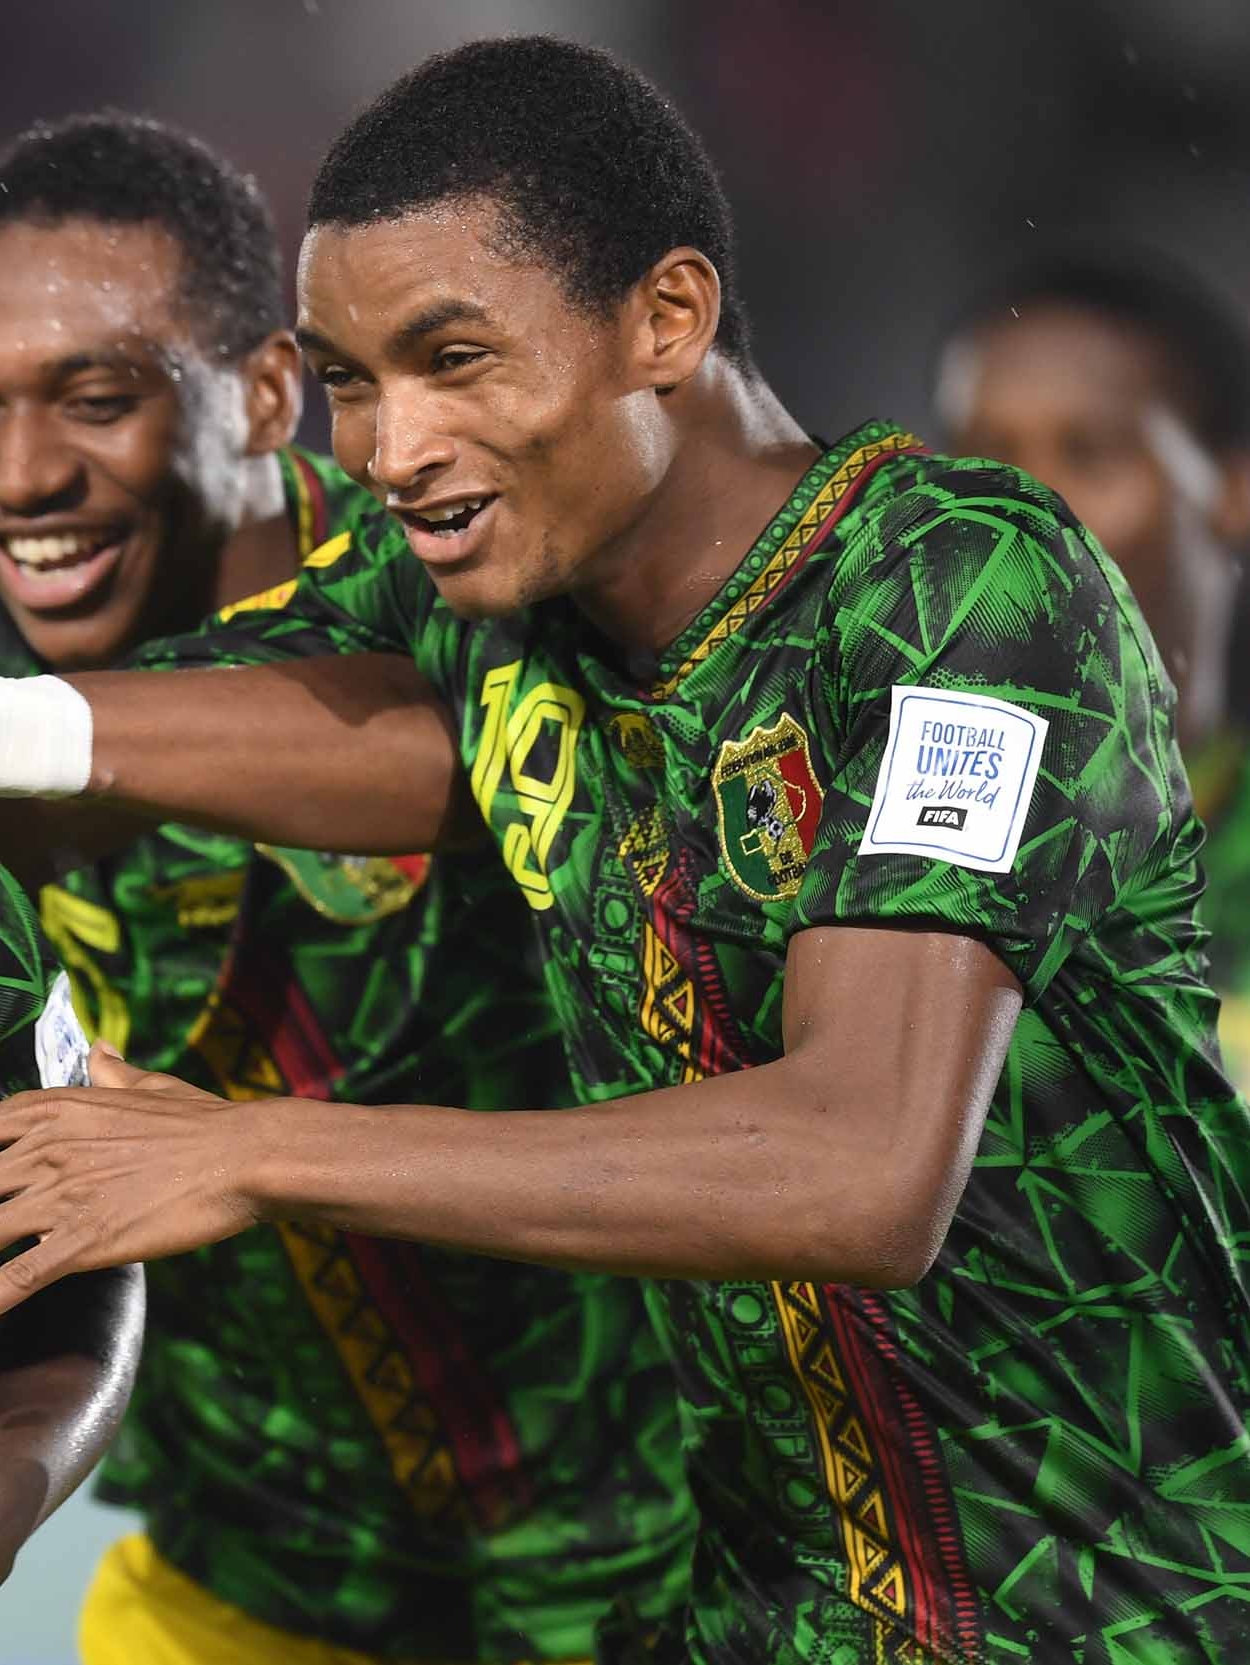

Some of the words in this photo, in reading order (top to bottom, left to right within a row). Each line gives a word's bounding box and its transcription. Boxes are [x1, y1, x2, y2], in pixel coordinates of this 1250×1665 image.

[921, 720, 1006, 752] FOOTBALL
[916, 745, 1003, 780] UNITES
[471, 659, 586, 910] 19
[905, 778, 937, 801] the
[937, 779, 1002, 810] World
[922, 809, 960, 826] FIFA
[767, 861, 807, 886] FOOTBA
